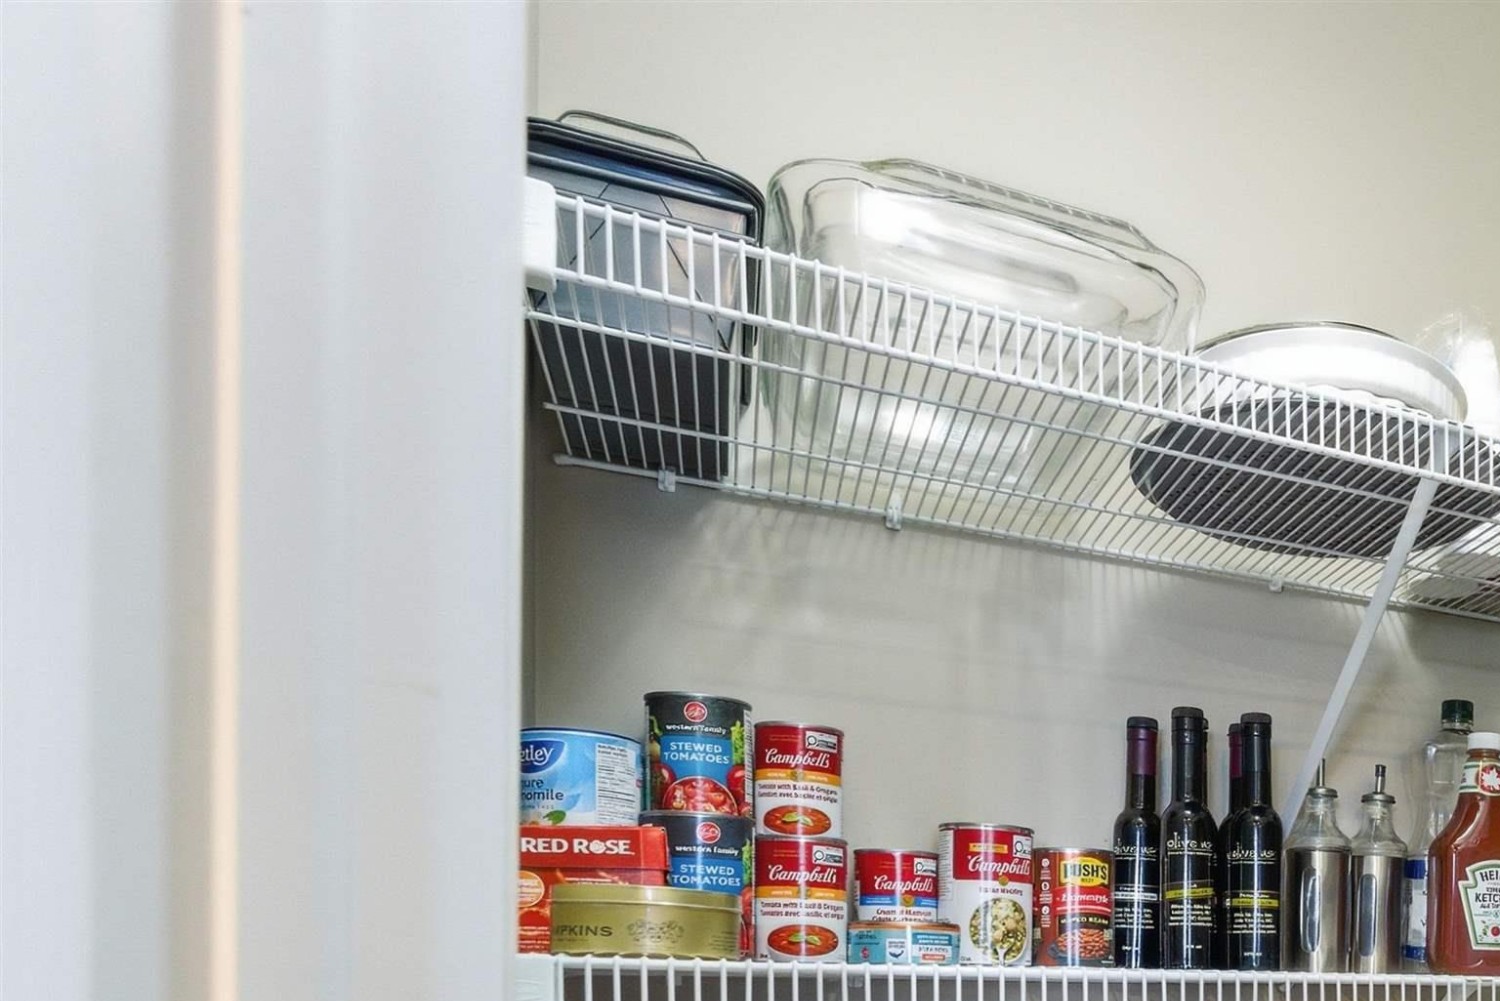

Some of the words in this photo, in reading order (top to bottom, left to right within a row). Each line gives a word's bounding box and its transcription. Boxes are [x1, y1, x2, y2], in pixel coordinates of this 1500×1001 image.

[669, 741, 722, 754] STEWED
[663, 751, 731, 765] TOMATOES
[764, 747, 831, 769] Campbell's
[520, 837, 569, 854] RED
[573, 838, 632, 855] ROSE
[680, 863, 735, 876] STEWED
[767, 863, 838, 885] Campbell's
[672, 874, 741, 887] TOMATOES
[873, 874, 934, 894] Campbell's
